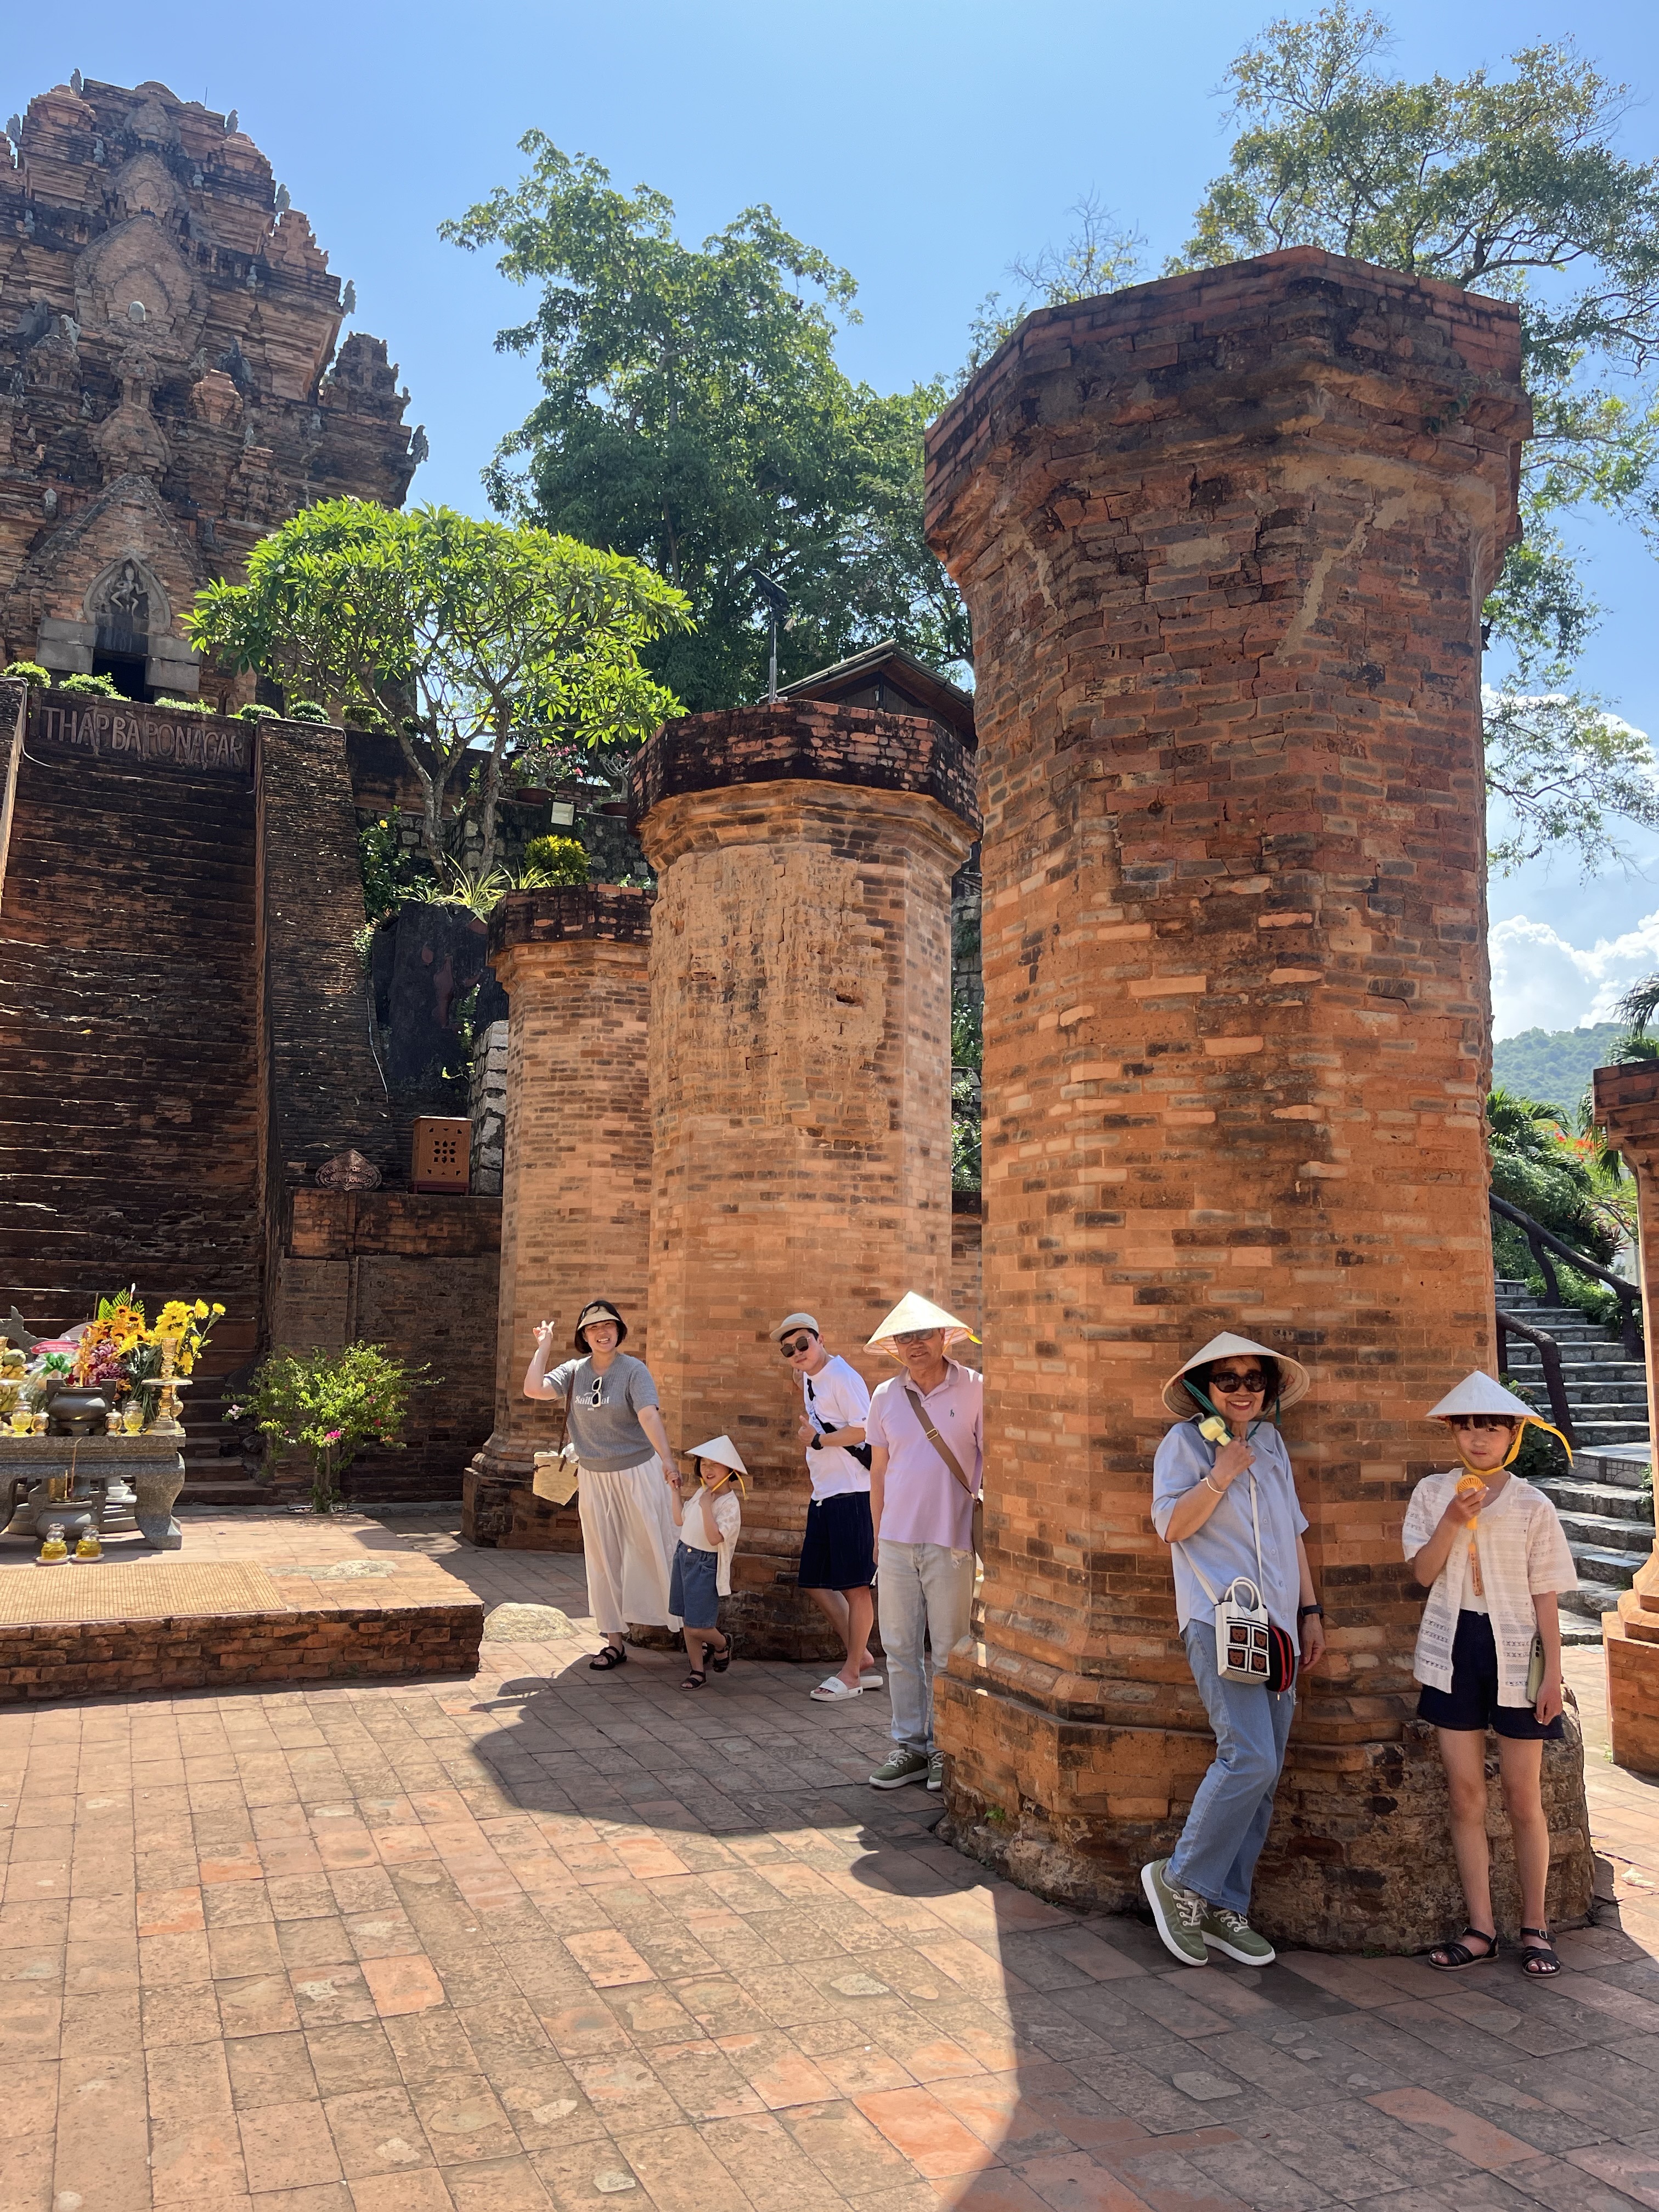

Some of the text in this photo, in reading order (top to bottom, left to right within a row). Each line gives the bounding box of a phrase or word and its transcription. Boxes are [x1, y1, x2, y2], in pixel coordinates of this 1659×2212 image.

[41, 705, 110, 746] THÁP
[111, 710, 142, 754] BÀ
[574, 1395, 610, 1405] Sailat
